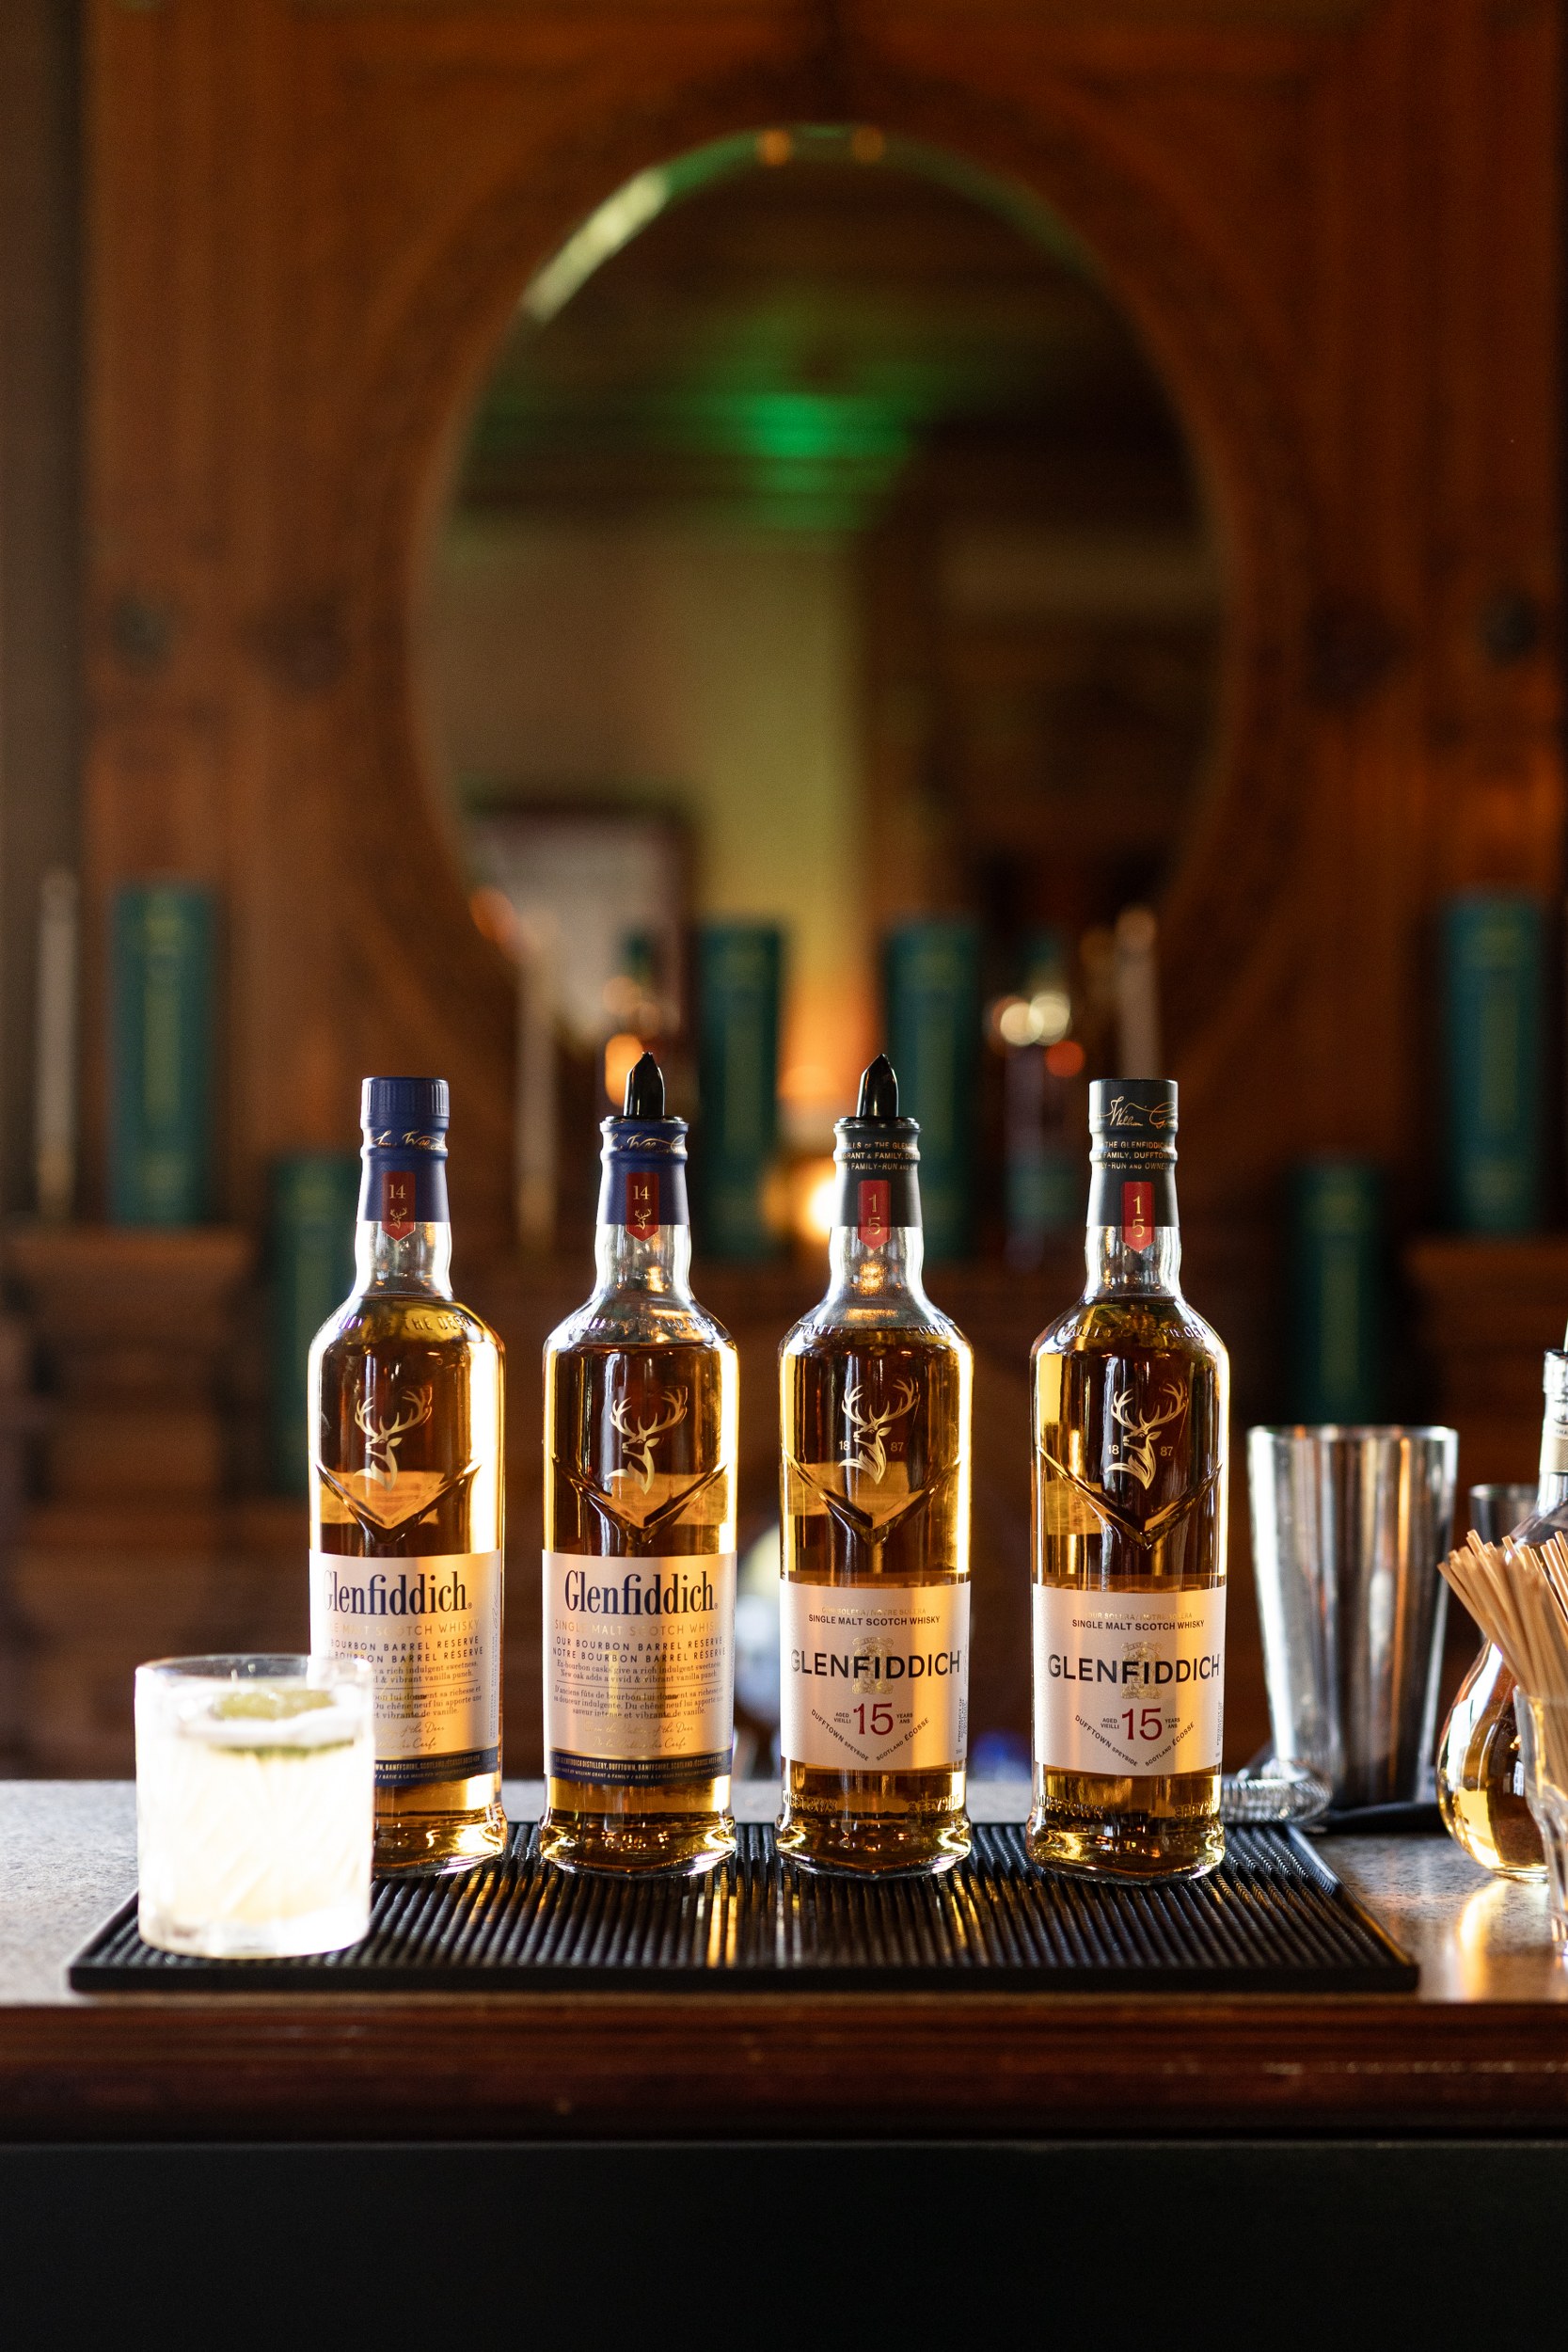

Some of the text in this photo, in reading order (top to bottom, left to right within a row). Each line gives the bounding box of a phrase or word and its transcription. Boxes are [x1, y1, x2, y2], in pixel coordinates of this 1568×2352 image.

[874, 1141, 890, 1150] THE
[1104, 1140, 1118, 1149] THE
[842, 1152, 864, 1160] GRANT
[850, 1162, 898, 1170] FAMILY-RUN
[388, 1184, 405, 1200] 14
[632, 1185, 650, 1200] 14
[838, 1439, 904, 1453] 18 87
[1107, 1444, 1174, 1456] 18 87
[564, 1569, 714, 1615] Glenfiddich
[438, 1618, 480, 1634] WHISKY
[554, 1618, 585, 1633] SINGL
[592, 1624, 623, 1636] MALT
[689, 1620, 715, 1634] WHIS
[808, 1613, 941, 1627] SINGLE MALT SCOTCH WHISKY
[1072, 1618, 1205, 1631] SINGLE MALT SCOTCH WHISKY
[384, 1642, 430, 1652] BARREL
[437, 1635, 479, 1648] RESERVE
[556, 1635, 722, 1652] OUR BOURBON BARREL RESERVE
[391, 1653, 437, 1663] BARREL
[444, 1646, 483, 1661] RÉSERVE
[552, 1646, 577, 1659] NOTRE
[580, 1651, 638, 1663] BOURBON
[645, 1653, 689, 1663] BARREL
[387, 1666, 404, 1675] rich
[405, 1664, 444, 1675] indulgent
[640, 1666, 657, 1675] rich
[658, 1663, 694, 1675] indulgent
[791, 1648, 960, 1679] GLENFIDDICH
[1048, 1653, 1220, 1685] GLENFIDDICH
[390, 1675, 422, 1684] vibrant
[424, 1671, 451, 1682] vanilla
[585, 1673, 603, 1682] adds
[634, 1675, 641, 1683] &
[643, 1674, 674, 1684] vibrant
[676, 1672, 701, 1682] vanilla
[414, 1700, 432, 1709] neuf
[445, 1696, 471, 1708] apporte
[607, 1692, 641, 1701] bourbon
[625, 1701, 638, 1709] Du
[640, 1700, 665, 1709] chêne
[666, 1701, 682, 1709] neuf
[624, 1710, 632, 1719] et
[852, 1702, 895, 1736] 15
[1121, 1707, 1163, 1741] 15
[811, 1708, 869, 1761] DUFFTOWN SPEYSIDE
[876, 1717, 930, 1761] SCOTLAND ÉCOSSE
[1074, 1713, 1138, 1767] DUFFTOWN SPEYSIDE
[1145, 1745, 1172, 1767] SCOTLAND
[1172, 1721, 1195, 1746] ÉCOSSE
